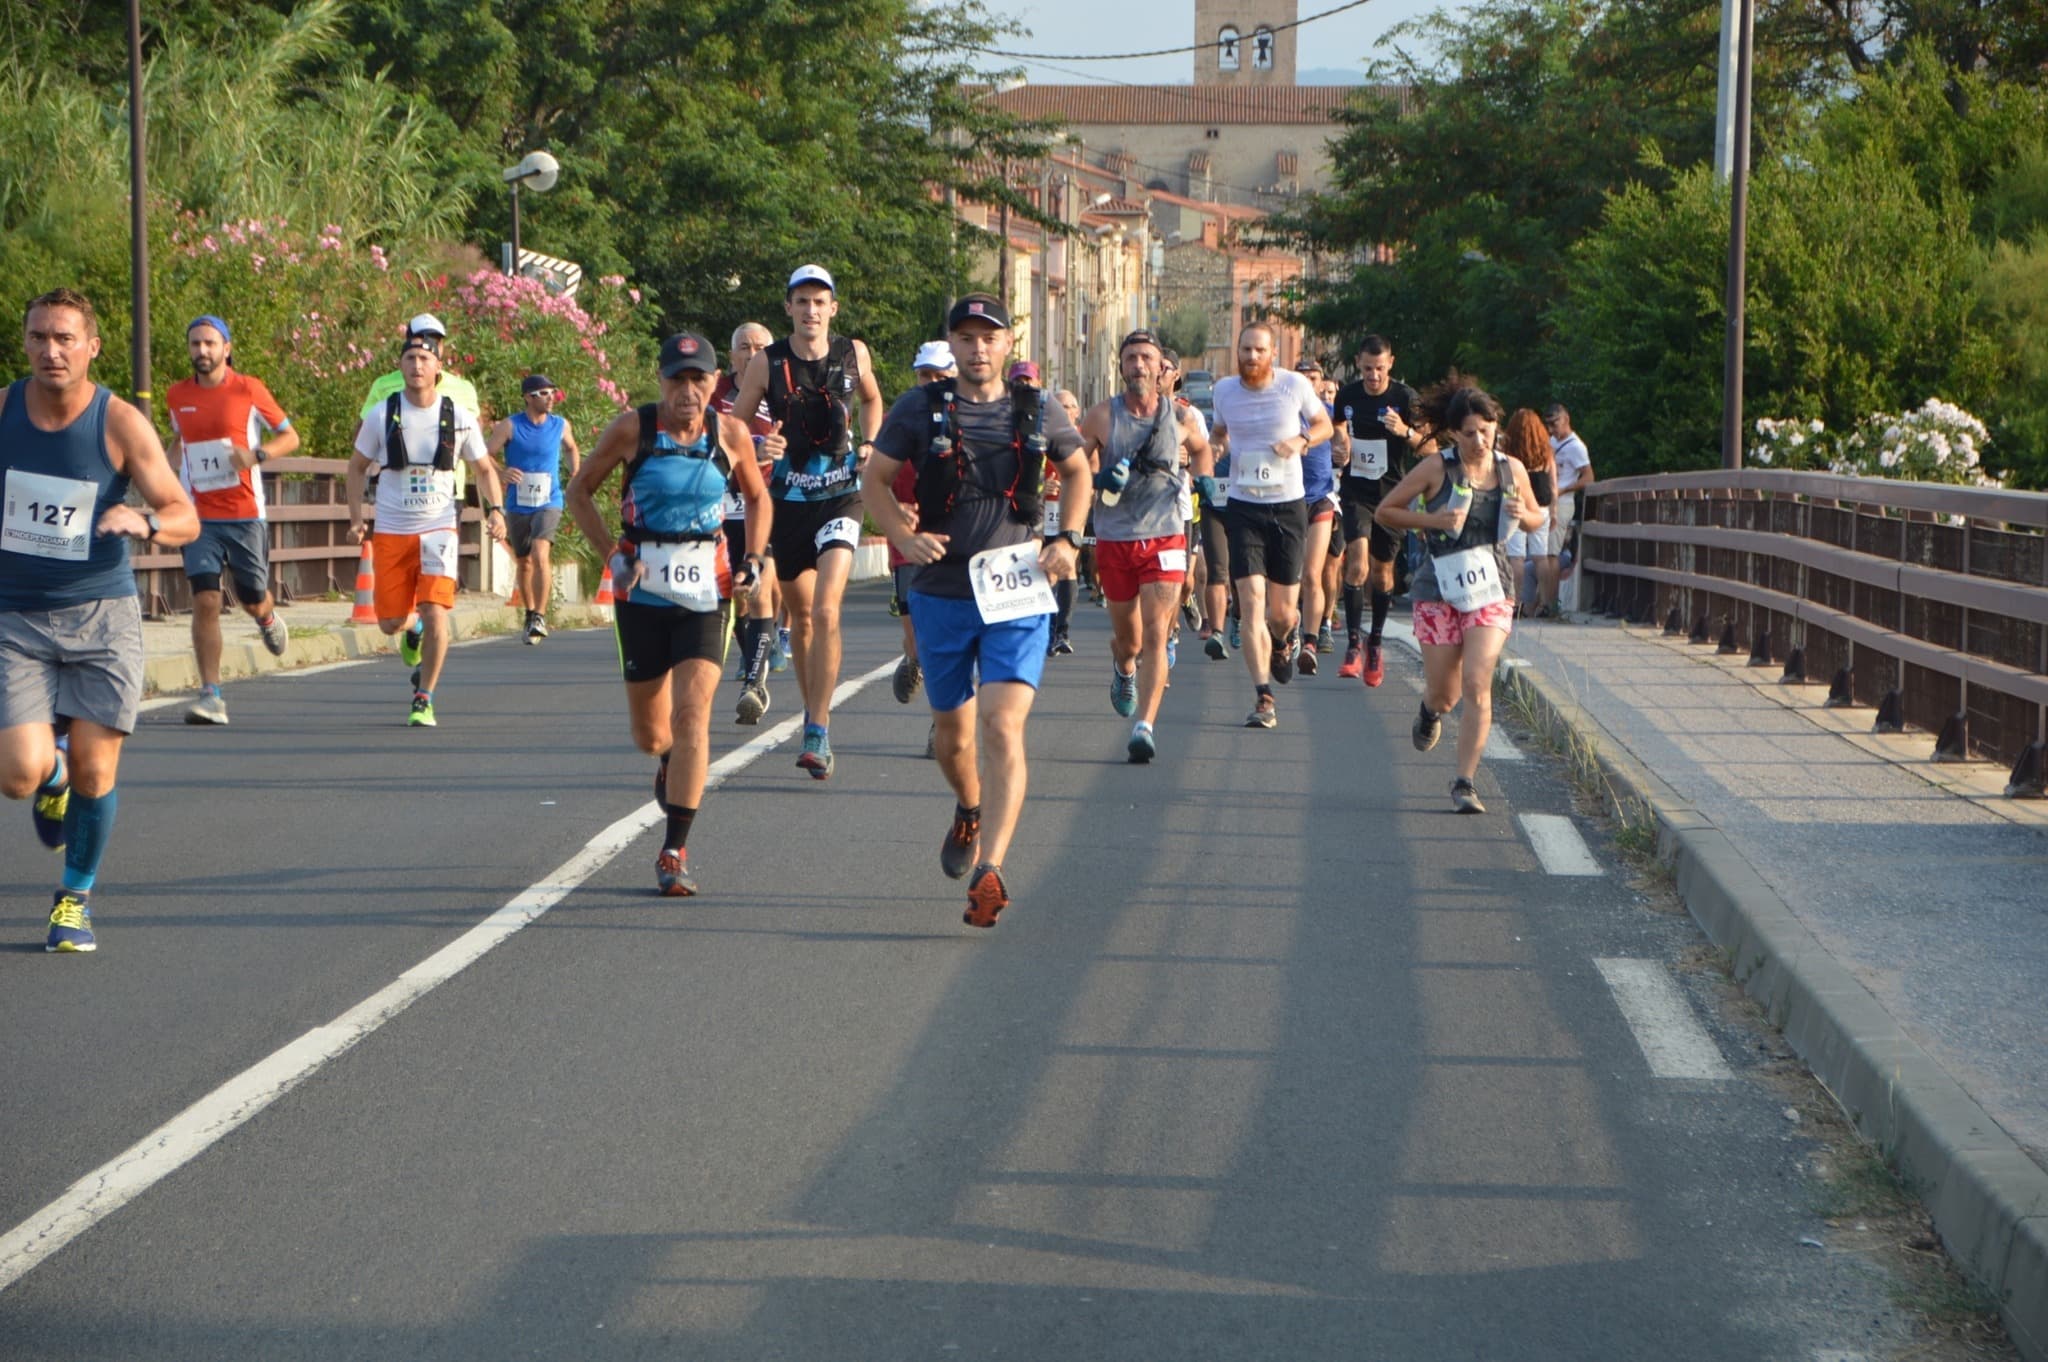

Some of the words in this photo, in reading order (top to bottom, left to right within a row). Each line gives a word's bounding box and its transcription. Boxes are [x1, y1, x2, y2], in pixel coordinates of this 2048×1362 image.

[201, 457, 219, 471] 71
[1360, 452, 1375, 463] 82
[1254, 466, 1269, 480] 16
[528, 484, 541, 493] 74
[28, 502, 77, 526] 127
[660, 565, 700, 583] 166
[991, 568, 1032, 592] 205
[1455, 566, 1486, 588] 101
